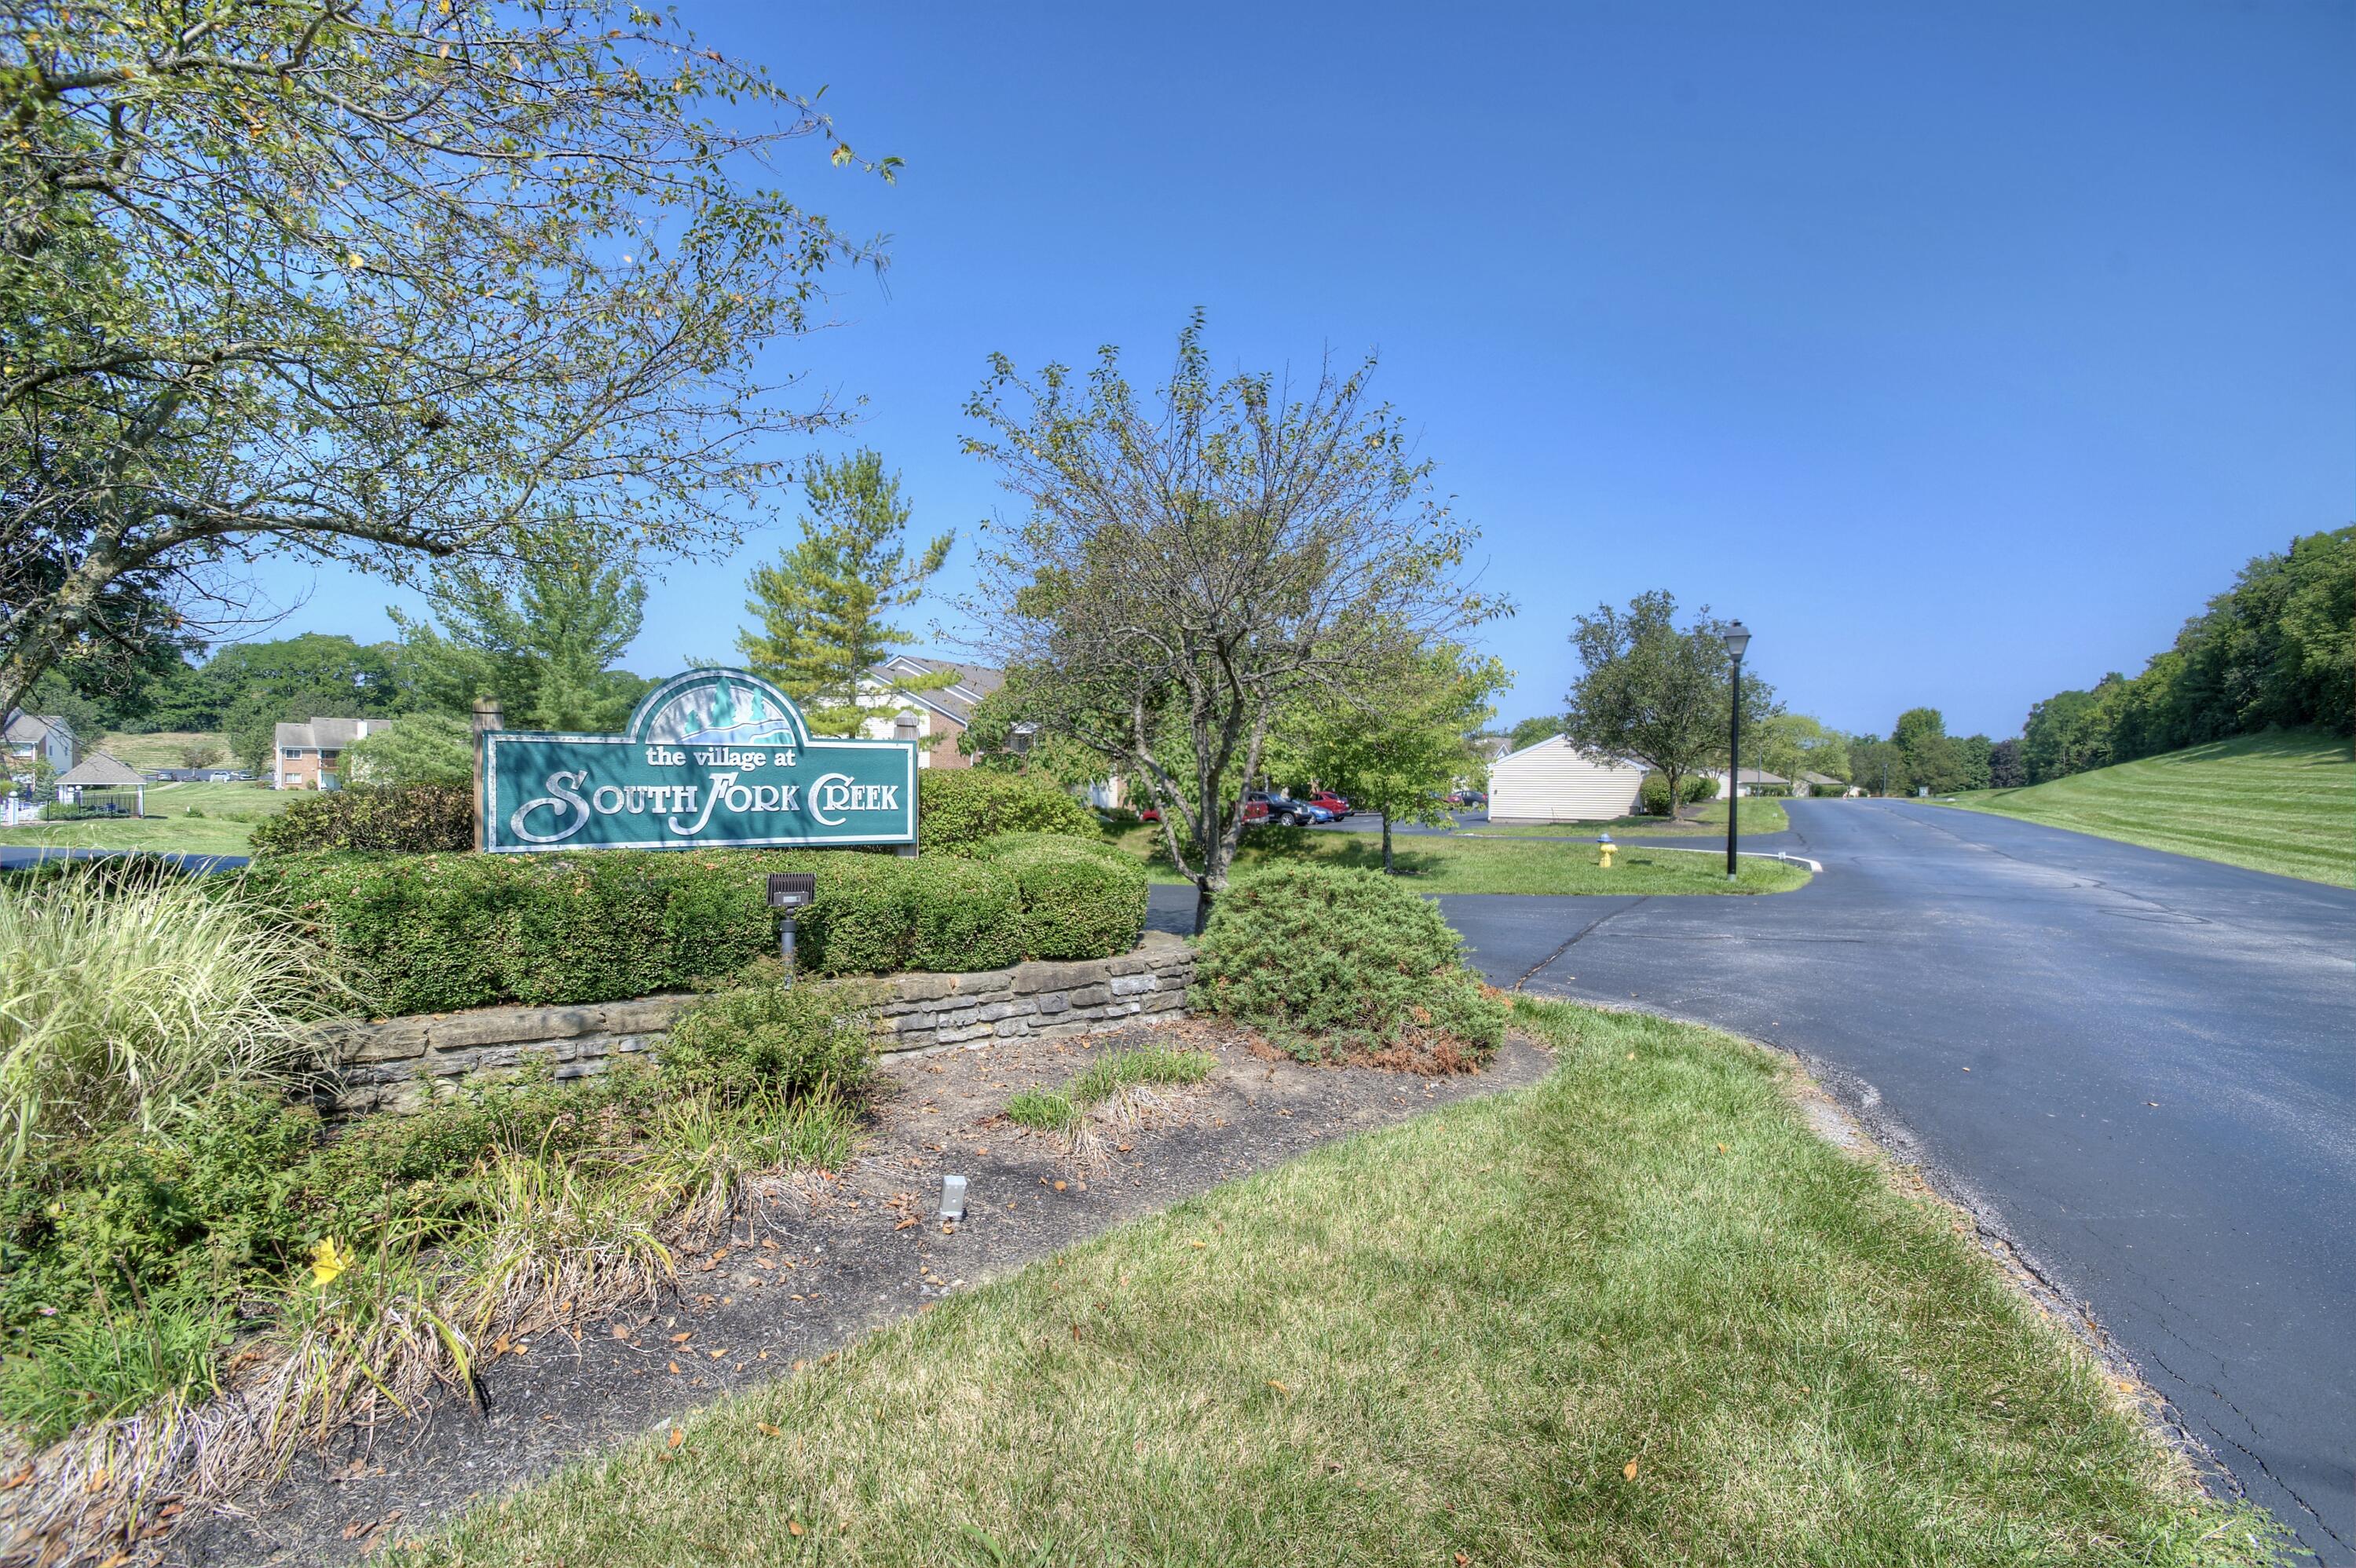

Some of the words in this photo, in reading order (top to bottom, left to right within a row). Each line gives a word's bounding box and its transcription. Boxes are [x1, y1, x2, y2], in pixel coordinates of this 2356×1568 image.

[646, 747, 686, 766] the
[693, 747, 766, 771] village
[774, 749, 796, 767] at
[510, 770, 698, 842] SOUTH
[668, 772, 800, 835] FORK
[807, 773, 899, 825] CREEK
